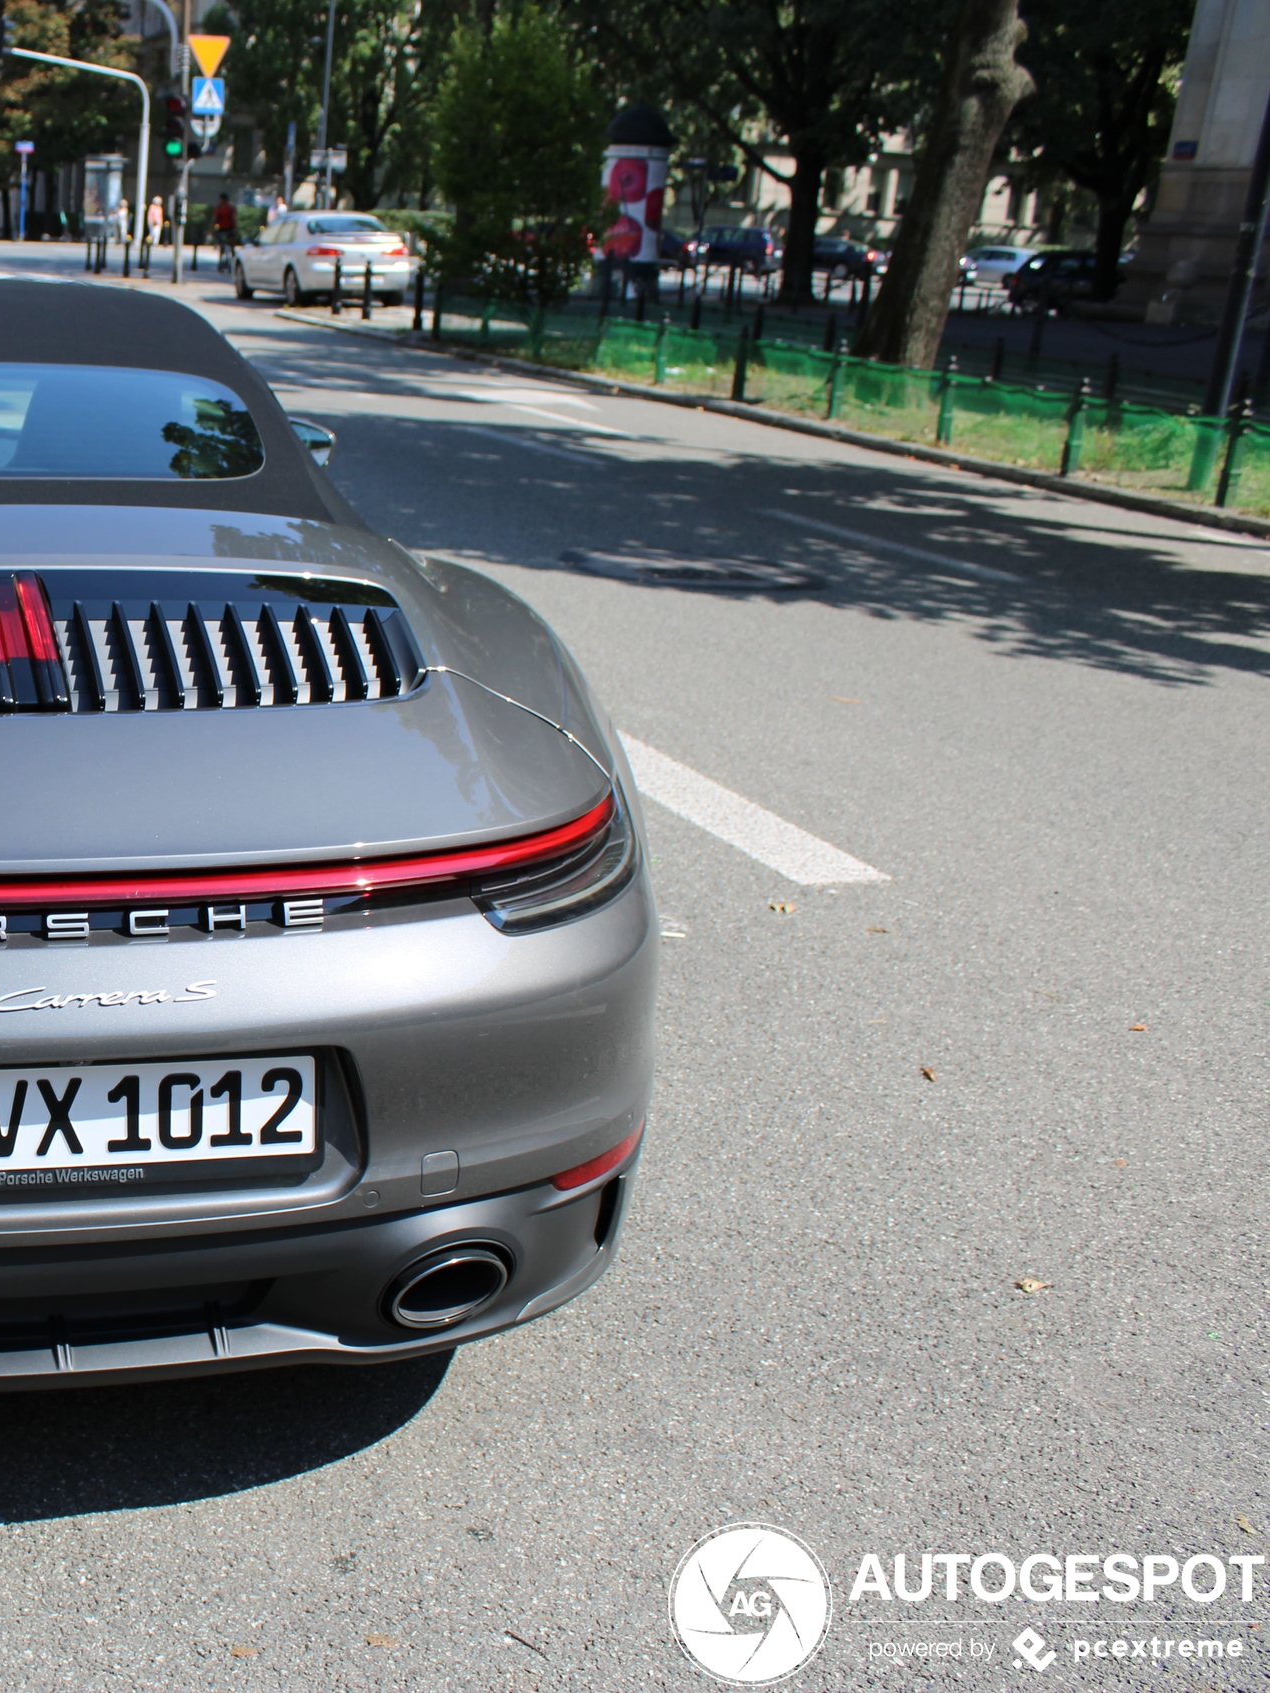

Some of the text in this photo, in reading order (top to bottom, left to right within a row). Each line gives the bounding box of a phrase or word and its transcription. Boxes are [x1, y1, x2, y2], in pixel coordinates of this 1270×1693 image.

[173, 980, 219, 1003] S
[107, 1067, 304, 1153] 1012
[54, 1167, 144, 1184] Werkswagen
